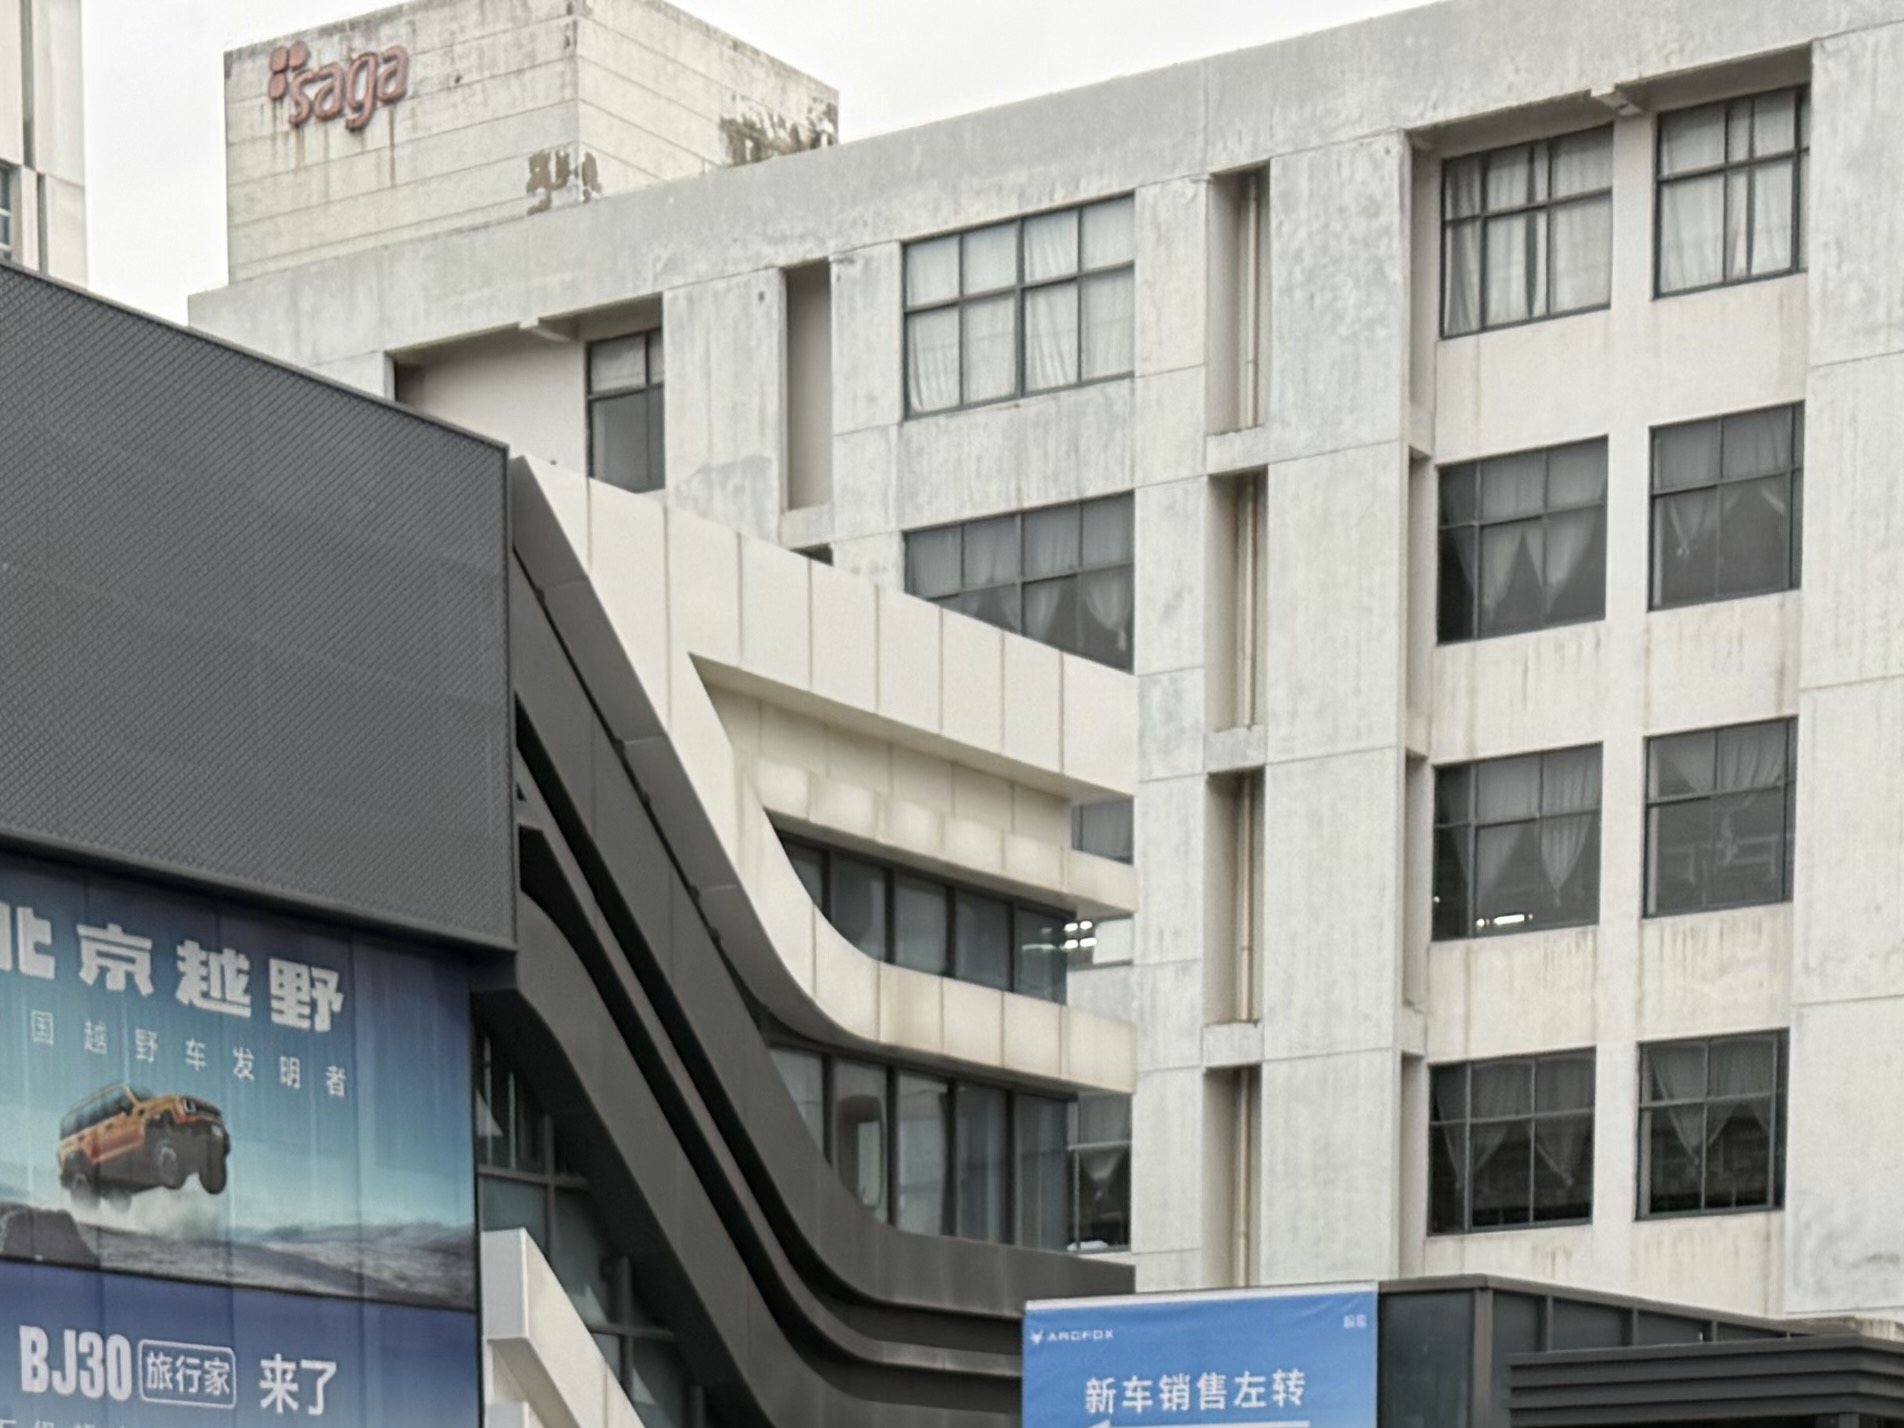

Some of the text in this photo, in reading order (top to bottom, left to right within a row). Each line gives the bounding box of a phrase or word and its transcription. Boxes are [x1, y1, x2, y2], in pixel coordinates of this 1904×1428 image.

[289, 46, 409, 132] saga
[1046, 1328, 1114, 1343] ARCFOX
[18, 1325, 338, 1416] BJ30 旅行家 来了
[1084, 1367, 1306, 1415] 新车销售左转
